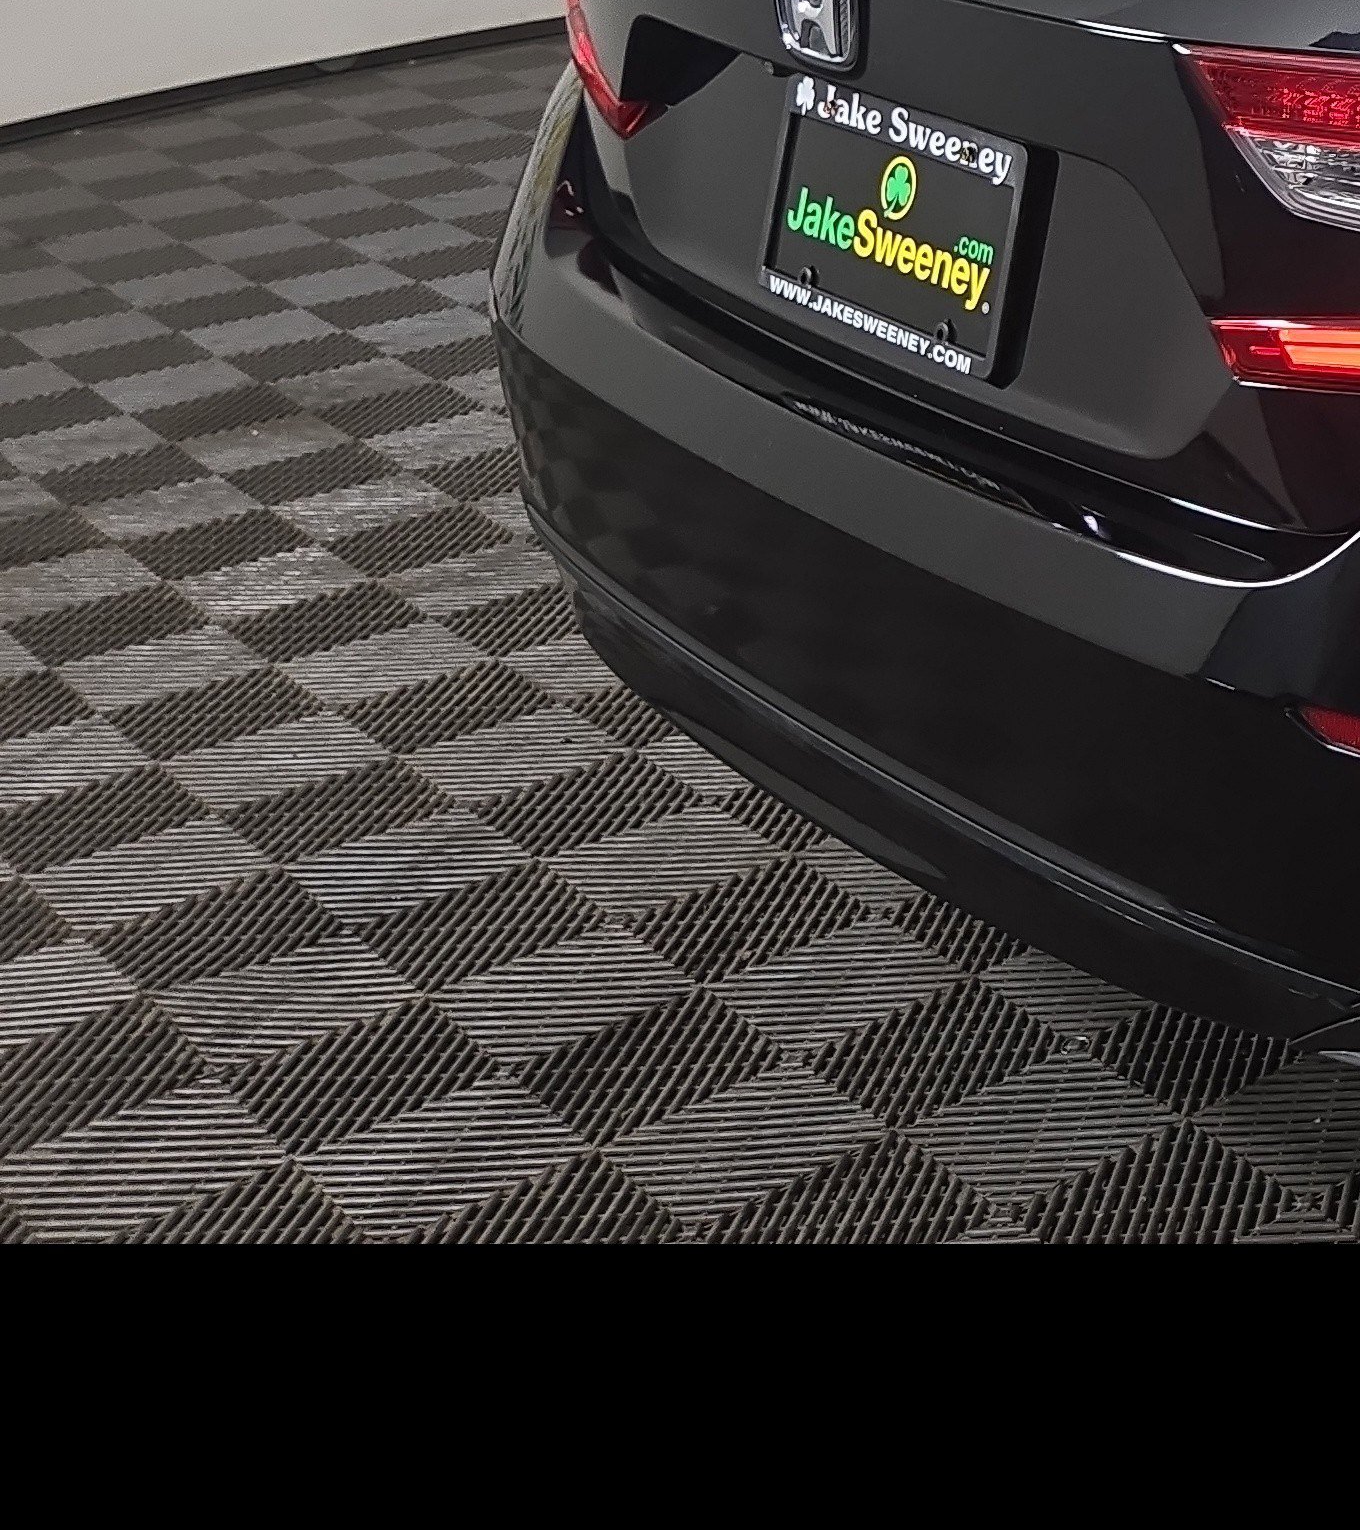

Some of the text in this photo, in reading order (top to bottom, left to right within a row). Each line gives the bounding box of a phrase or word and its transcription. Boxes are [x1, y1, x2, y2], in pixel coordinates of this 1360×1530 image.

[816, 84, 1014, 186] Jake Sweeney
[768, 273, 973, 376] WWW.JAKESWEENEY.COM
